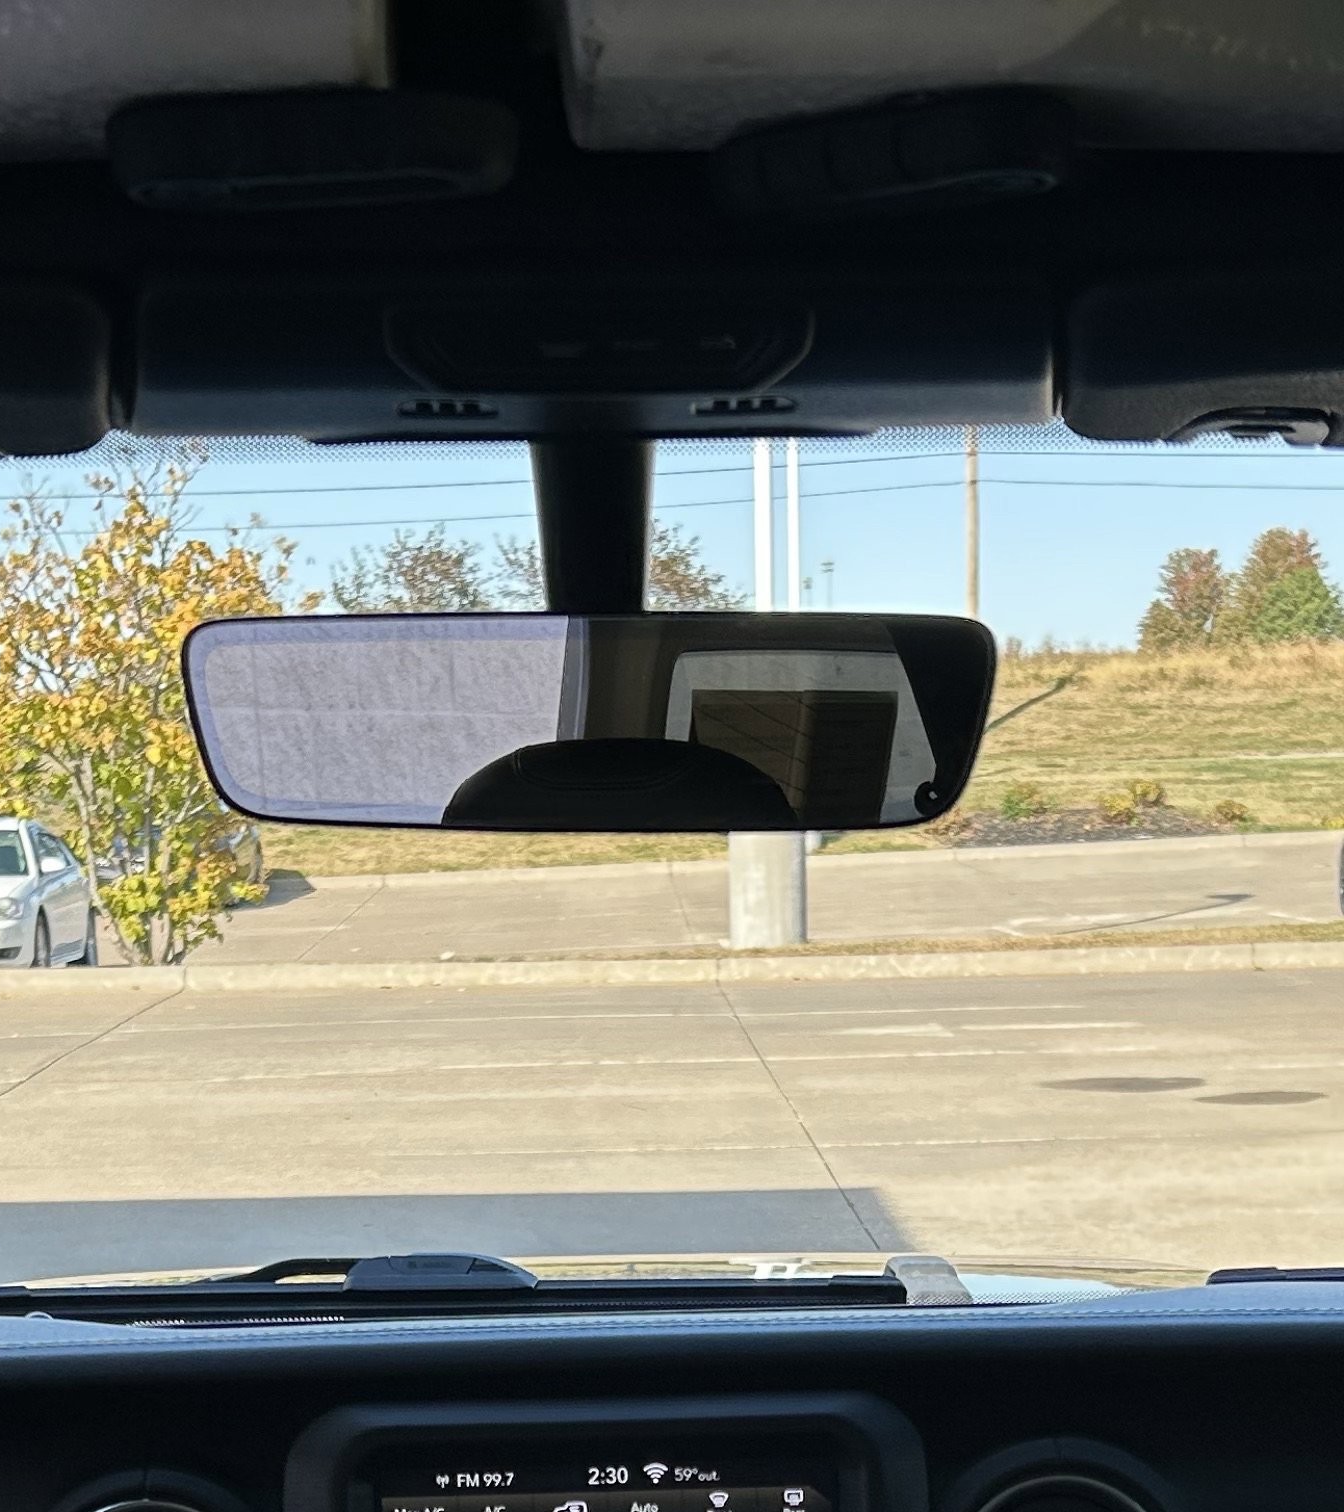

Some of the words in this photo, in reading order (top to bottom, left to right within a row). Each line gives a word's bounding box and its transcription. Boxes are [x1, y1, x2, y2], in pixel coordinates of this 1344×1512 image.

[456, 1473, 479, 1488] FM
[482, 1473, 514, 1488] 99.7
[588, 1467, 629, 1485] 2:30
